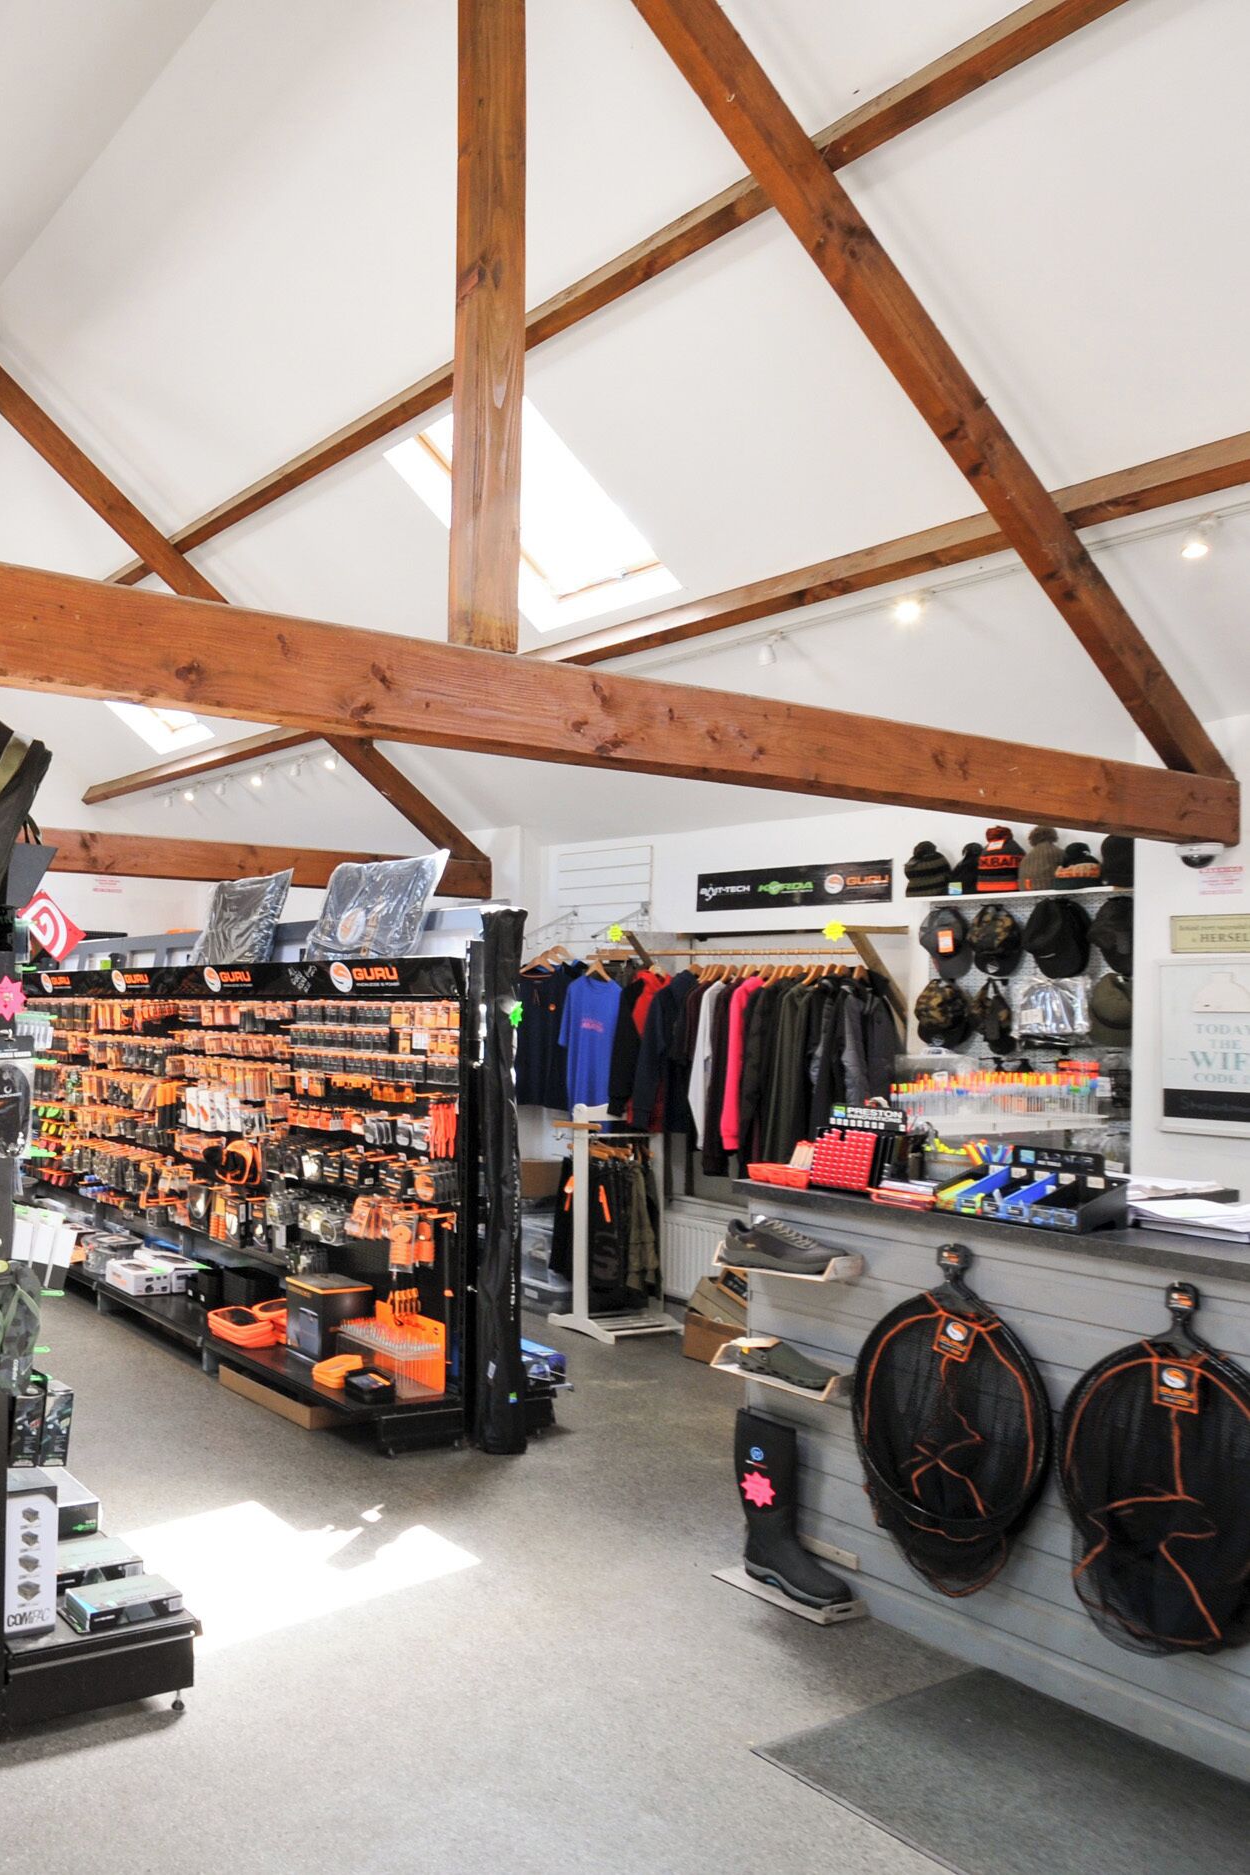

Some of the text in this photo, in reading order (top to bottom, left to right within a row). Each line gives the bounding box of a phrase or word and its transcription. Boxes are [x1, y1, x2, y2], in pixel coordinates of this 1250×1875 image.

[845, 874, 890, 887] GURU
[757, 880, 814, 895] KORDA
[123, 973, 149, 985] GURU
[219, 970, 251, 983] GURU
[352, 965, 399, 981] GURU
[1209, 1039, 1242, 1050] THE
[1189, 1050, 1250, 1071] WIF
[1193, 1072, 1239, 1084] CODE
[847, 1106, 903, 1119] PRESTON
[6, 1607, 52, 1628] COMPAC
